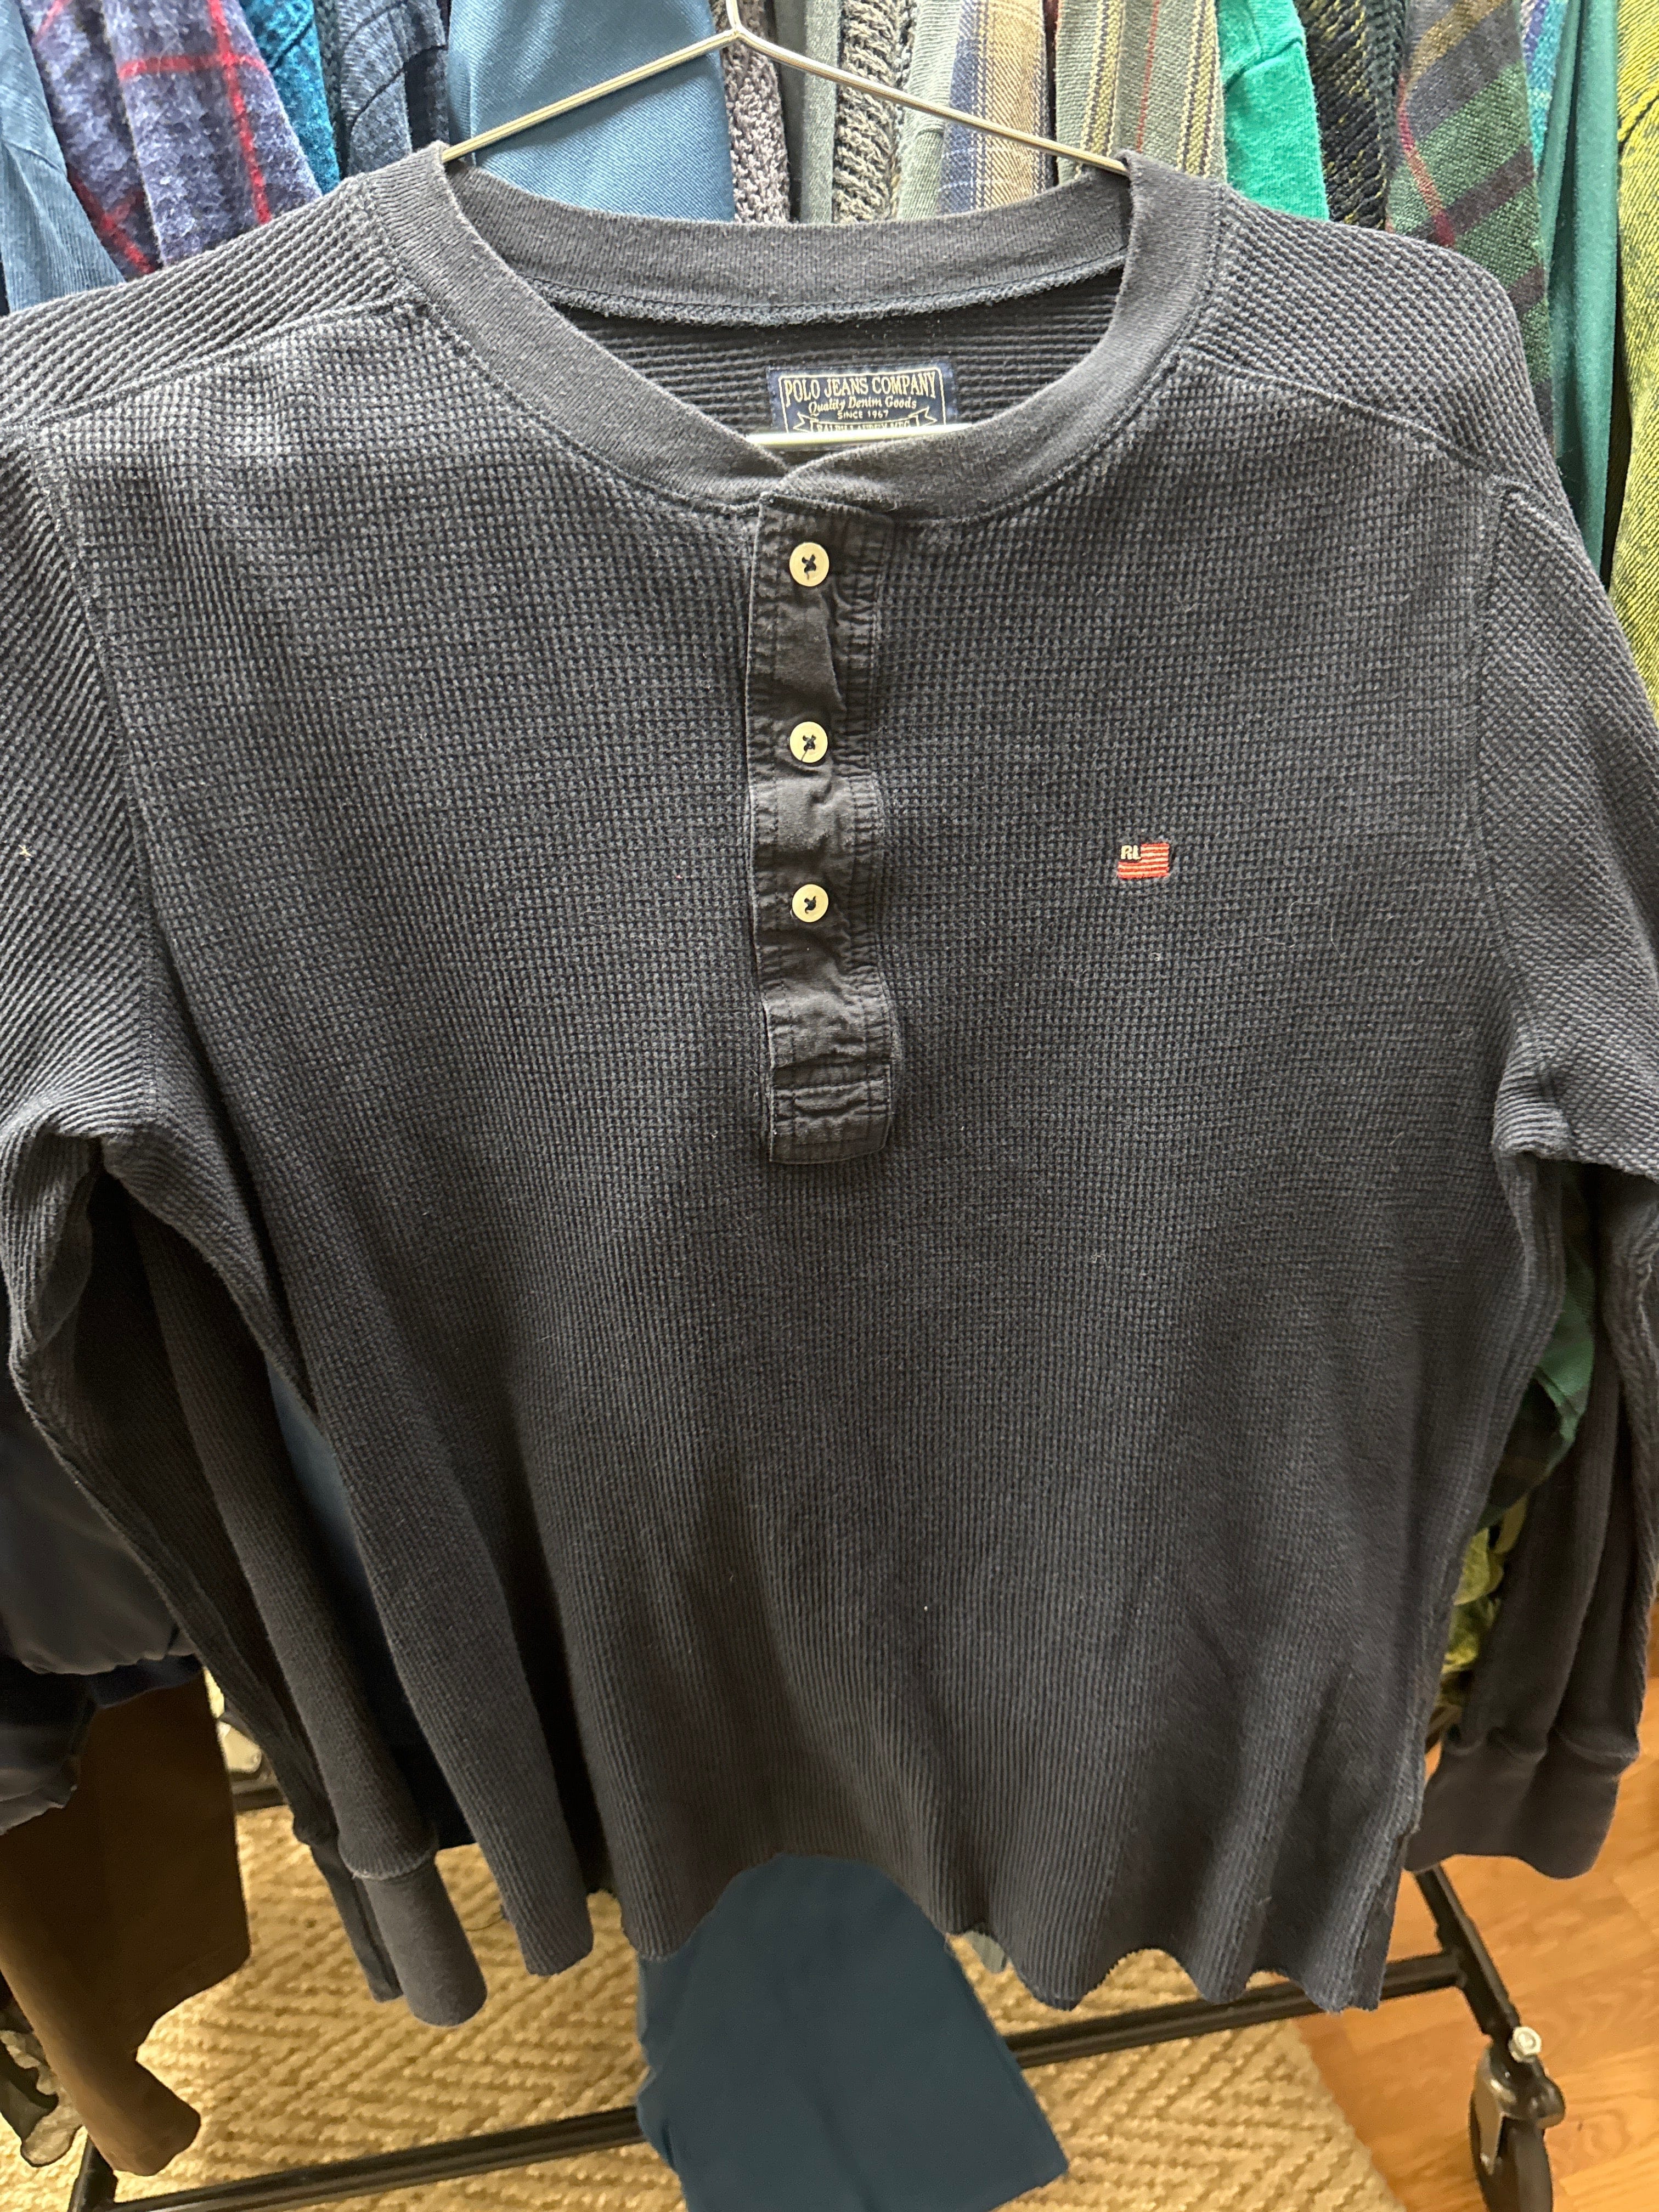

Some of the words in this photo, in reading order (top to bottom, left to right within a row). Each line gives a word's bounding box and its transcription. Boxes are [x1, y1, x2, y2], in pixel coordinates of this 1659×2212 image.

[783, 379, 821, 408] POLO
[824, 377, 867, 398] JEANS
[872, 372, 936, 399] COMPANY
[808, 398, 845, 416] Quality
[848, 396, 882, 409] Denim
[884, 395, 917, 409] Goods
[837, 410, 864, 419] SINCE
[867, 410, 889, 419] 1967
[1121, 845, 1141, 860] RL
